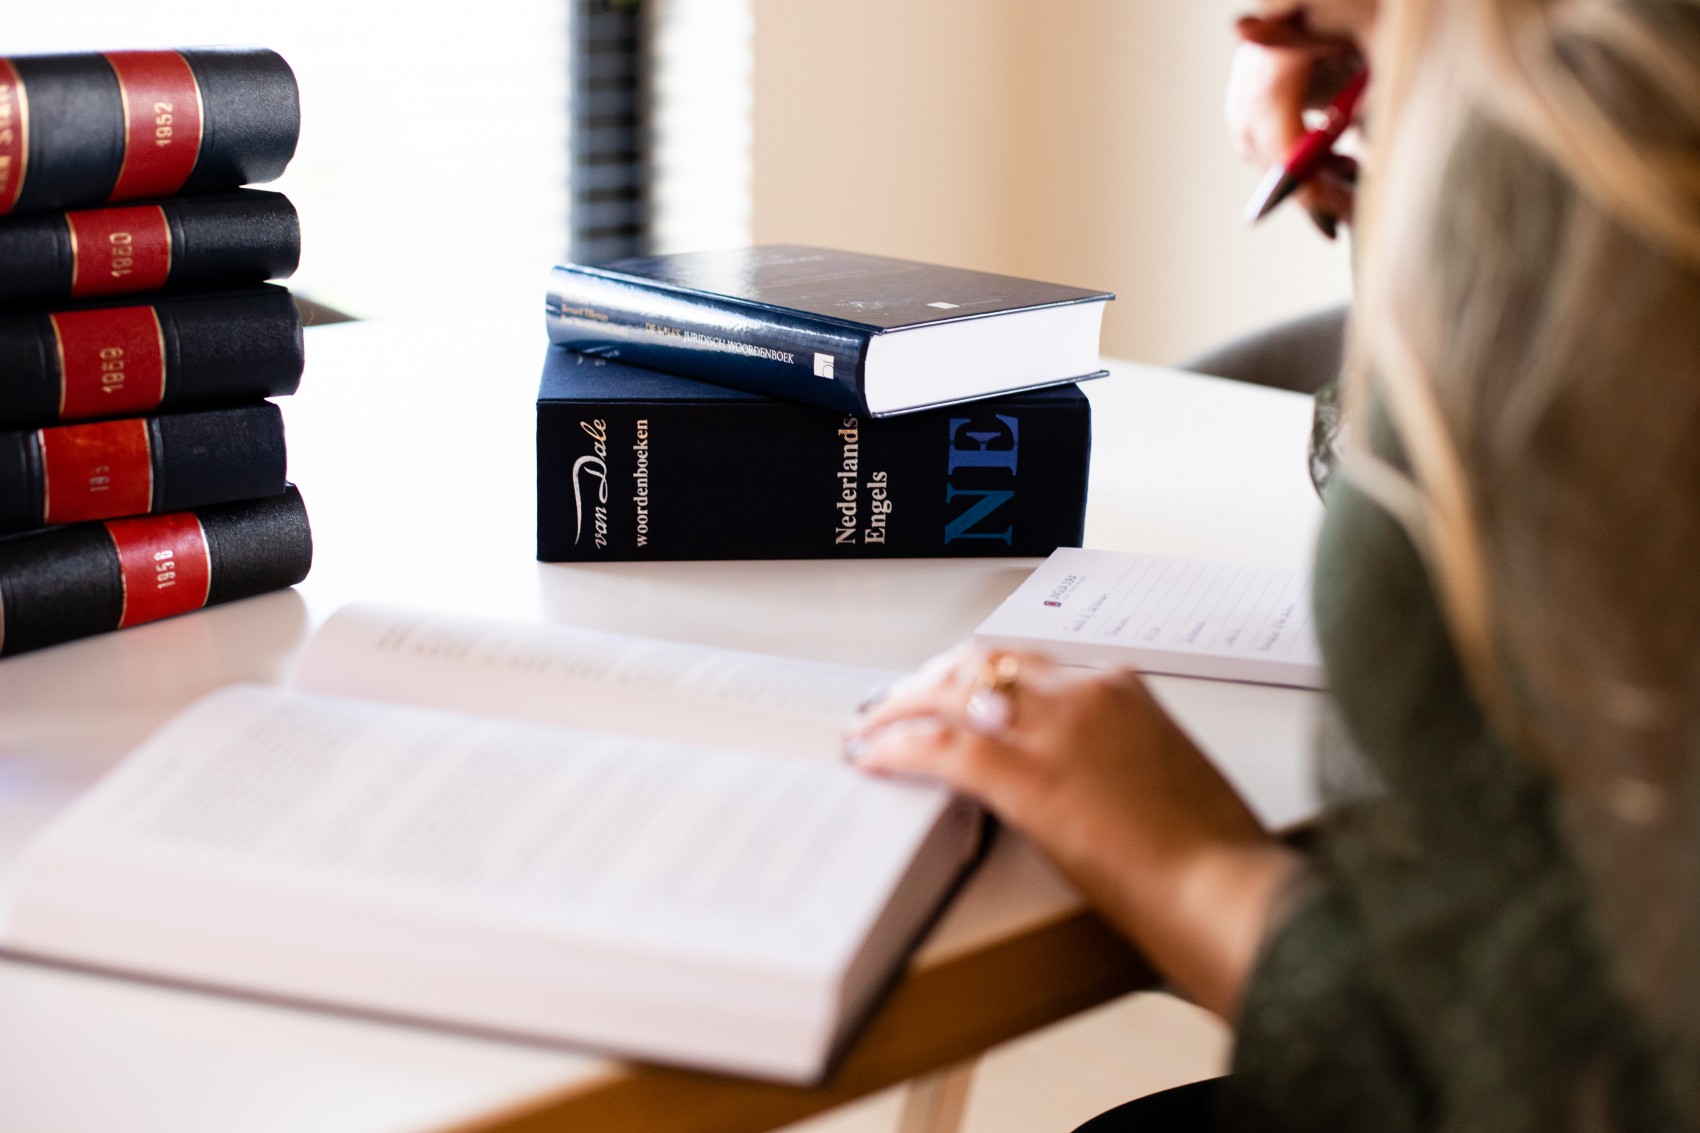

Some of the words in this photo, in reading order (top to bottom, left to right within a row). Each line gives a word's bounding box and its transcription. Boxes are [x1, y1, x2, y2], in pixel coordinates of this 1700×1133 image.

[155, 101, 173, 147] 1952
[683, 331, 726, 348] JURIDISCH
[726, 340, 795, 364] WOORDENBOEK
[573, 418, 608, 546] Dale
[633, 419, 650, 547] woordenboeken
[865, 471, 891, 545] Engels
[945, 413, 1020, 546] NE
[593, 506, 608, 550] van
